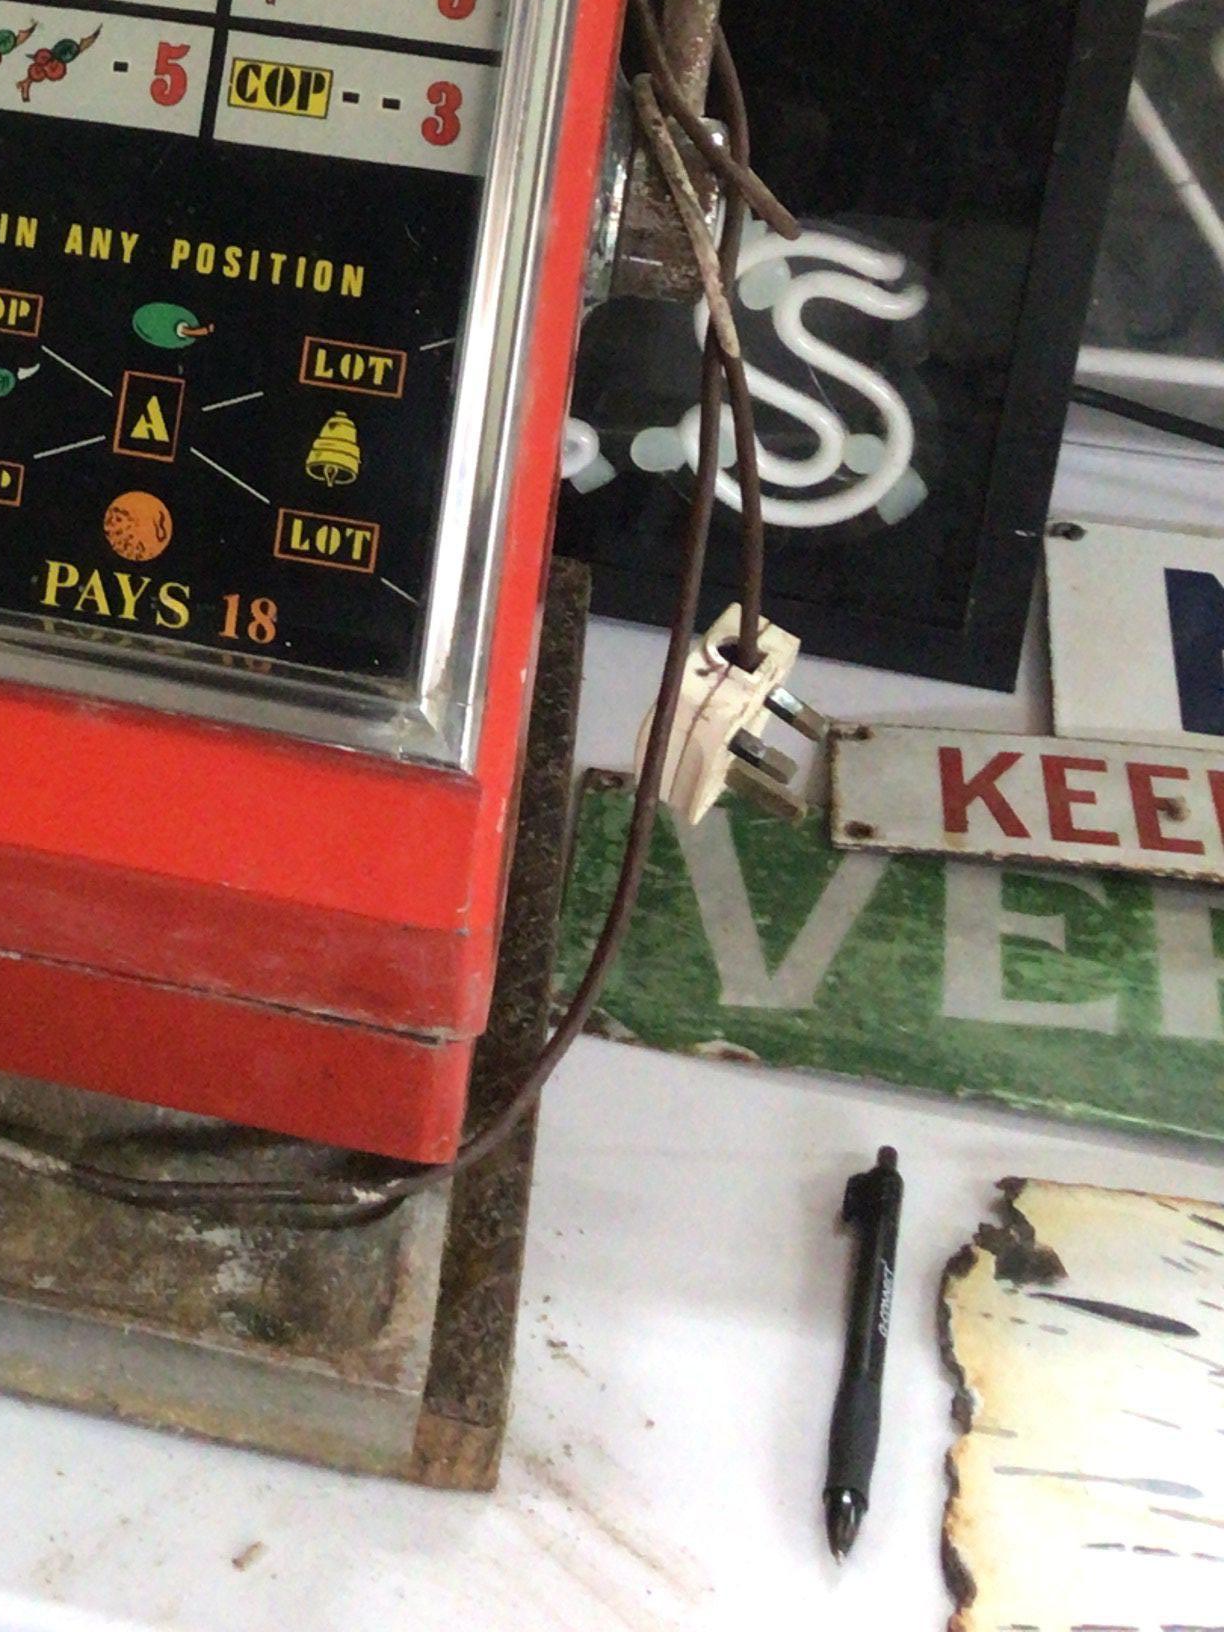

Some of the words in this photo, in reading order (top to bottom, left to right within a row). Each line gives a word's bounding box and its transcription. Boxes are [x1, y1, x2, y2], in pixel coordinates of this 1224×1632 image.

[149, 40, 192, 107] 5
[235, 63, 327, 111] COP
[421, 80, 463, 147] 3
[64, 223, 140, 264] ANY
[170, 238, 365, 299] POSITION
[313, 347, 394, 386] LOT
[129, 394, 170, 443] A
[289, 518, 371, 561] LOT
[40, 559, 191, 630] PAYS
[218, 592, 279, 645] 18
[938, 746, 1224, 856] KEE
